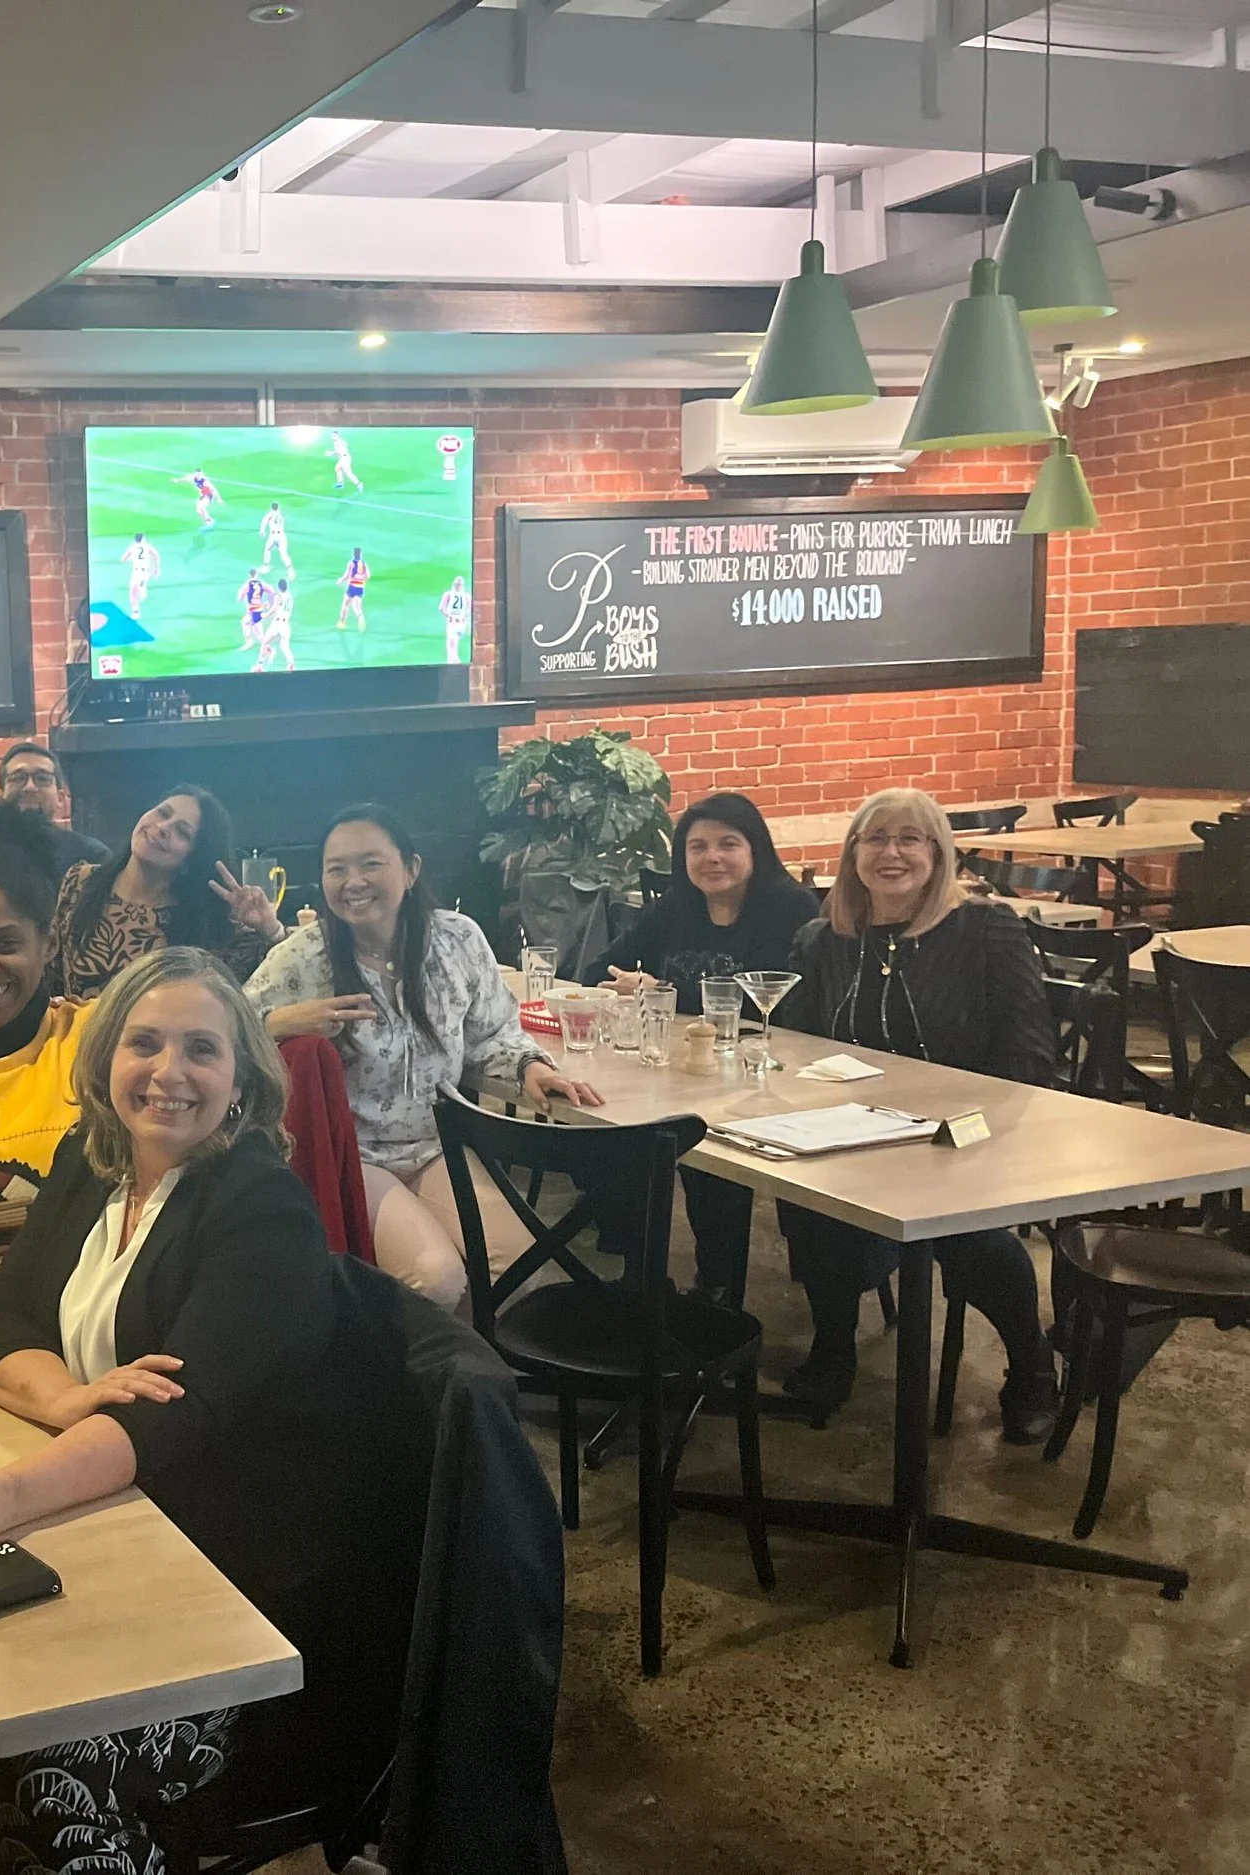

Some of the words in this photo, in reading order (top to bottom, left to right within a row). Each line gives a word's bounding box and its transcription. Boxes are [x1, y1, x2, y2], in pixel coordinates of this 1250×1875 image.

[645, 526, 681, 555] THE
[685, 525, 725, 554] FIRST
[729, 523, 779, 554] BOUNCE
[790, 522, 824, 550] PINTS
[831, 521, 855, 549] FOR
[859, 519, 914, 549] PURPOSE
[918, 518, 961, 546] TRIVIA
[969, 517, 1014, 545] LUNCH
[688, 556, 739, 583] STRONGER
[743, 555, 770, 581] MEN
[773, 551, 820, 580] BEYOND
[822, 551, 849, 578] THE
[813, 584, 882, 622] RAISED
[605, 605, 659, 636] BOYS
[539, 650, 597, 672] SUPPORTING
[604, 636, 658, 672] BUSH
